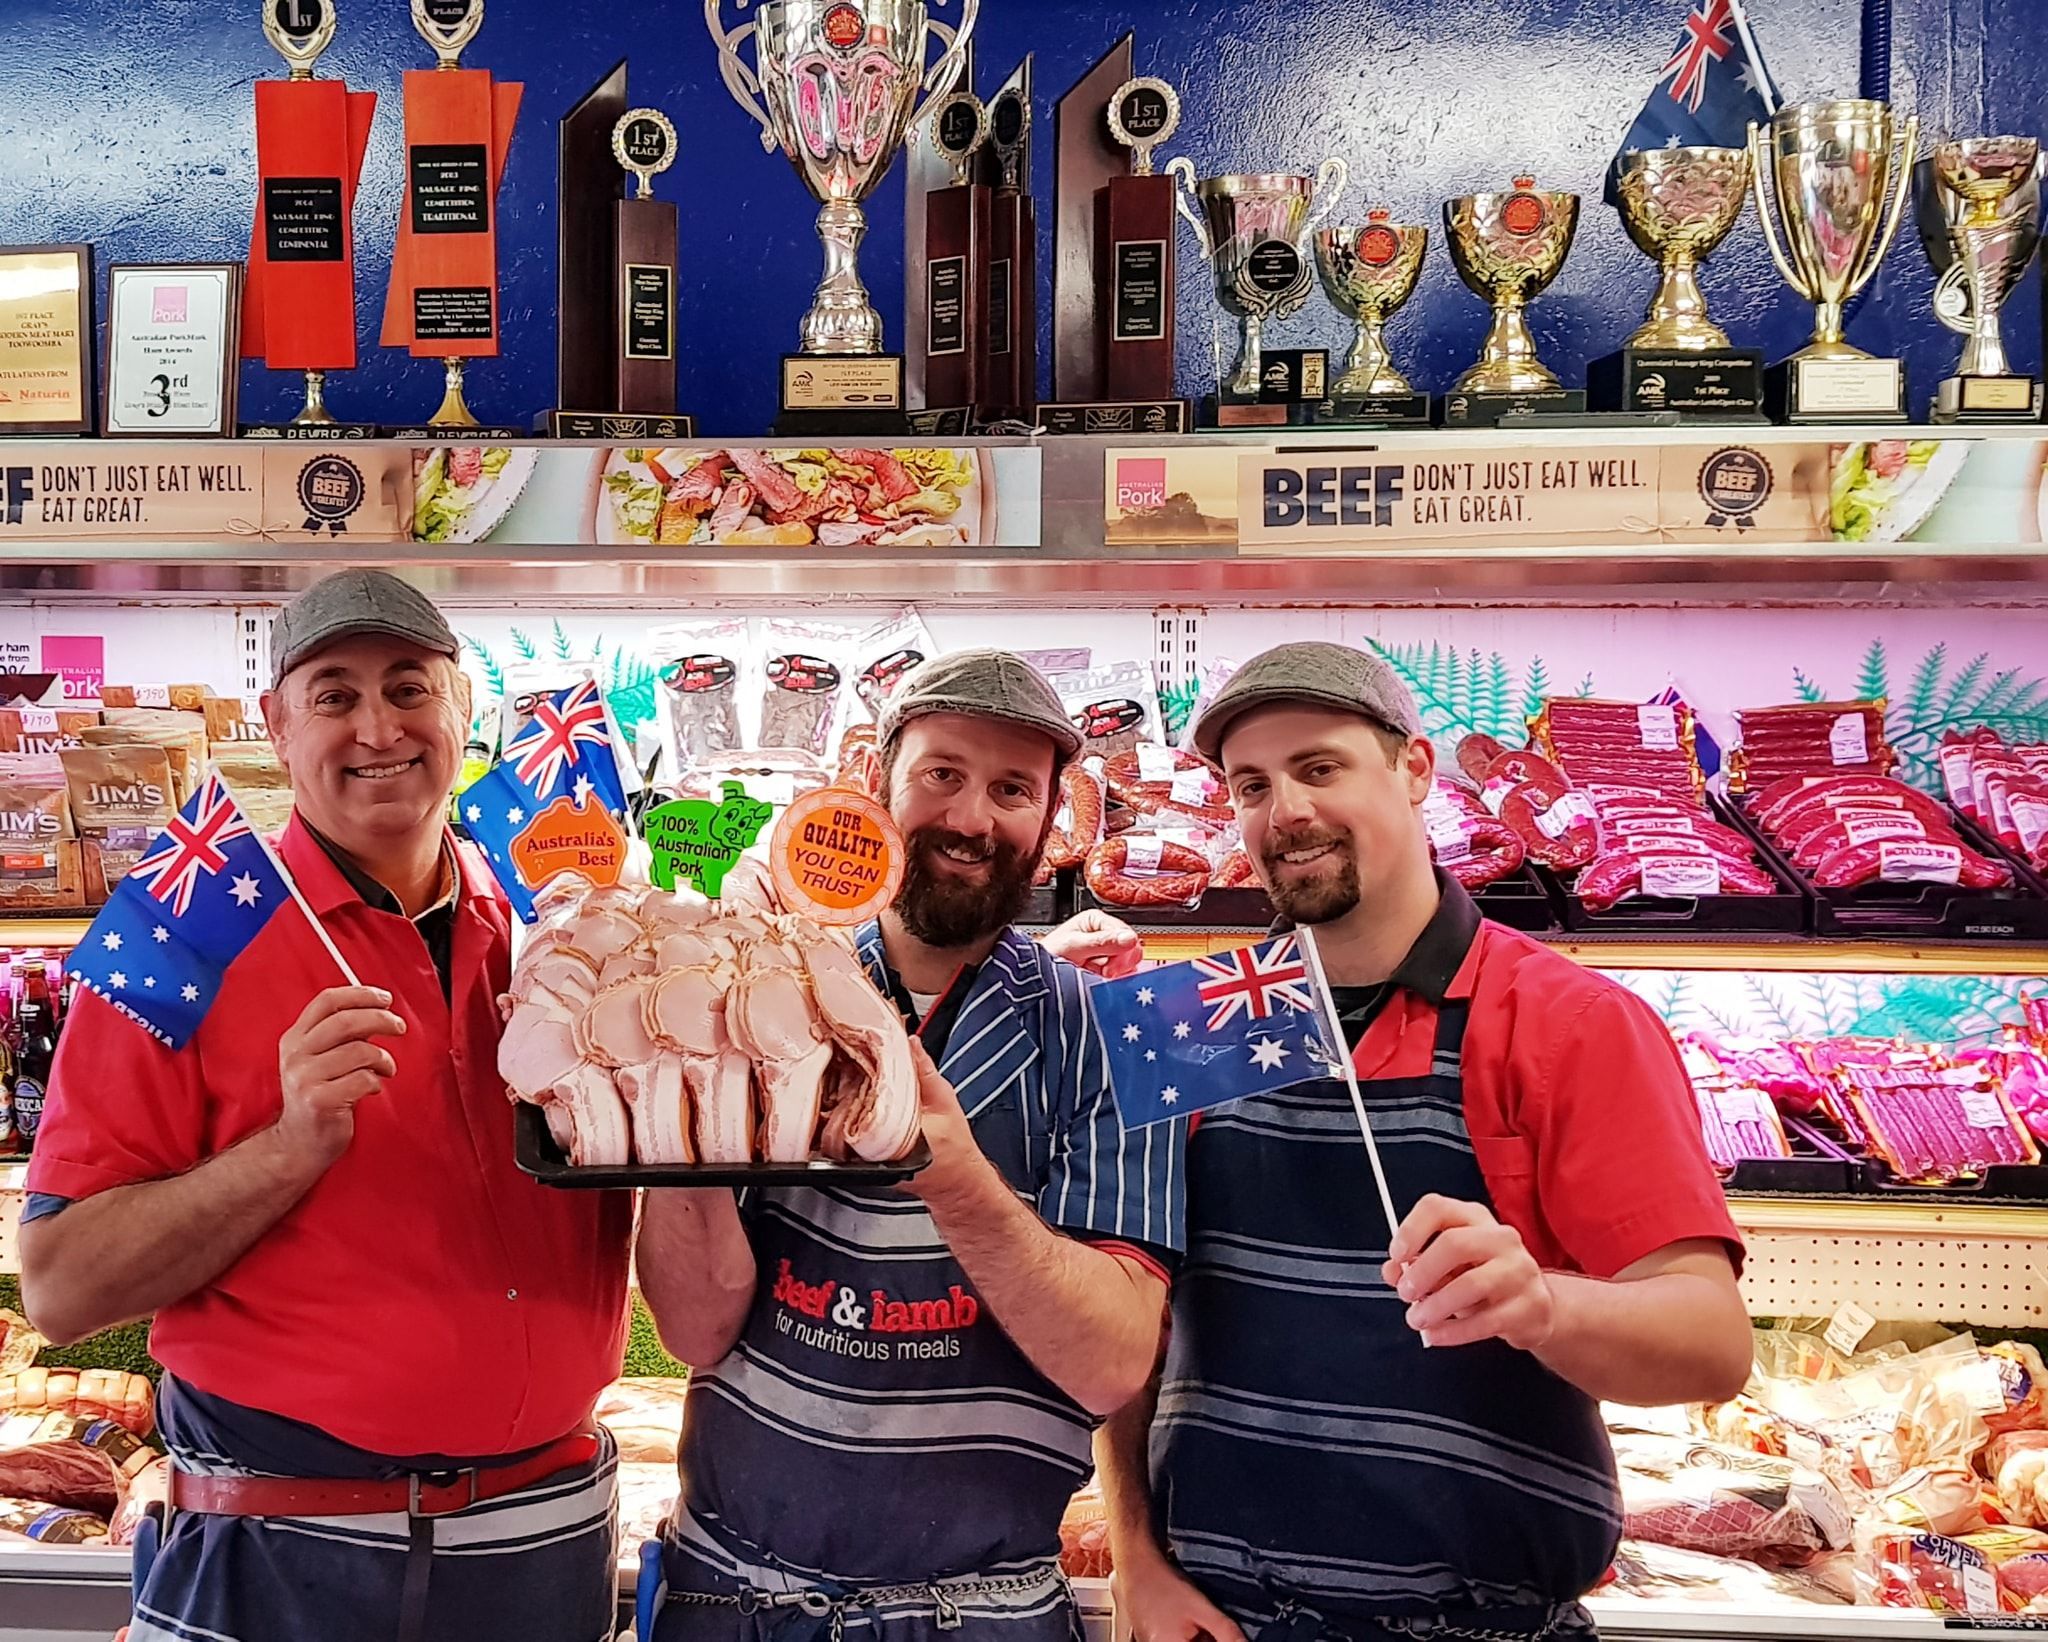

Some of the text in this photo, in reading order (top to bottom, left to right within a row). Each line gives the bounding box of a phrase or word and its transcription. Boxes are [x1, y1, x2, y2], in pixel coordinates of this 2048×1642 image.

[433, 7, 464, 15] PLACE
[1130, 98, 1161, 118] 1ST
[1128, 118, 1161, 129] PLACE
[633, 124, 659, 146] 1ST
[629, 146, 660, 156] PLACE
[152, 308, 186, 323] Pork
[20, 389, 71, 400] Naturin
[42, 464, 253, 492] DON'T JUST EAT WELL.
[1413, 459, 1648, 492] DON'T JUST EAT WELL.
[1713, 469, 1758, 492] BEEF
[0, 466, 34, 525] F
[312, 477, 351, 498] BEEF
[1117, 487, 1165, 506] Pork
[1263, 465, 1404, 528] BEEF
[42, 497, 149, 523] EAT GREAT.
[1413, 495, 1533, 524] EAT GREAT.
[6, 643, 30, 652] ham
[8, 654, 30, 662] from
[63, 675, 101, 697] ork
[82, 779, 166, 806] JIM'S
[108, 803, 142, 811] JERKY
[660, 813, 701, 836] 100%
[832, 809, 862, 832] OUR
[525, 833, 616, 854] Australia's
[653, 833, 731, 862] Australian
[803, 823, 885, 862] QUALITY
[577, 850, 616, 867] Best
[668, 859, 703, 878] Pork
[793, 846, 881, 883] YOU CAN
[801, 868, 866, 899] TRUST
[773, 1257, 978, 1333] beef & lamb
[774, 1307, 961, 1361] for nutritious meals
